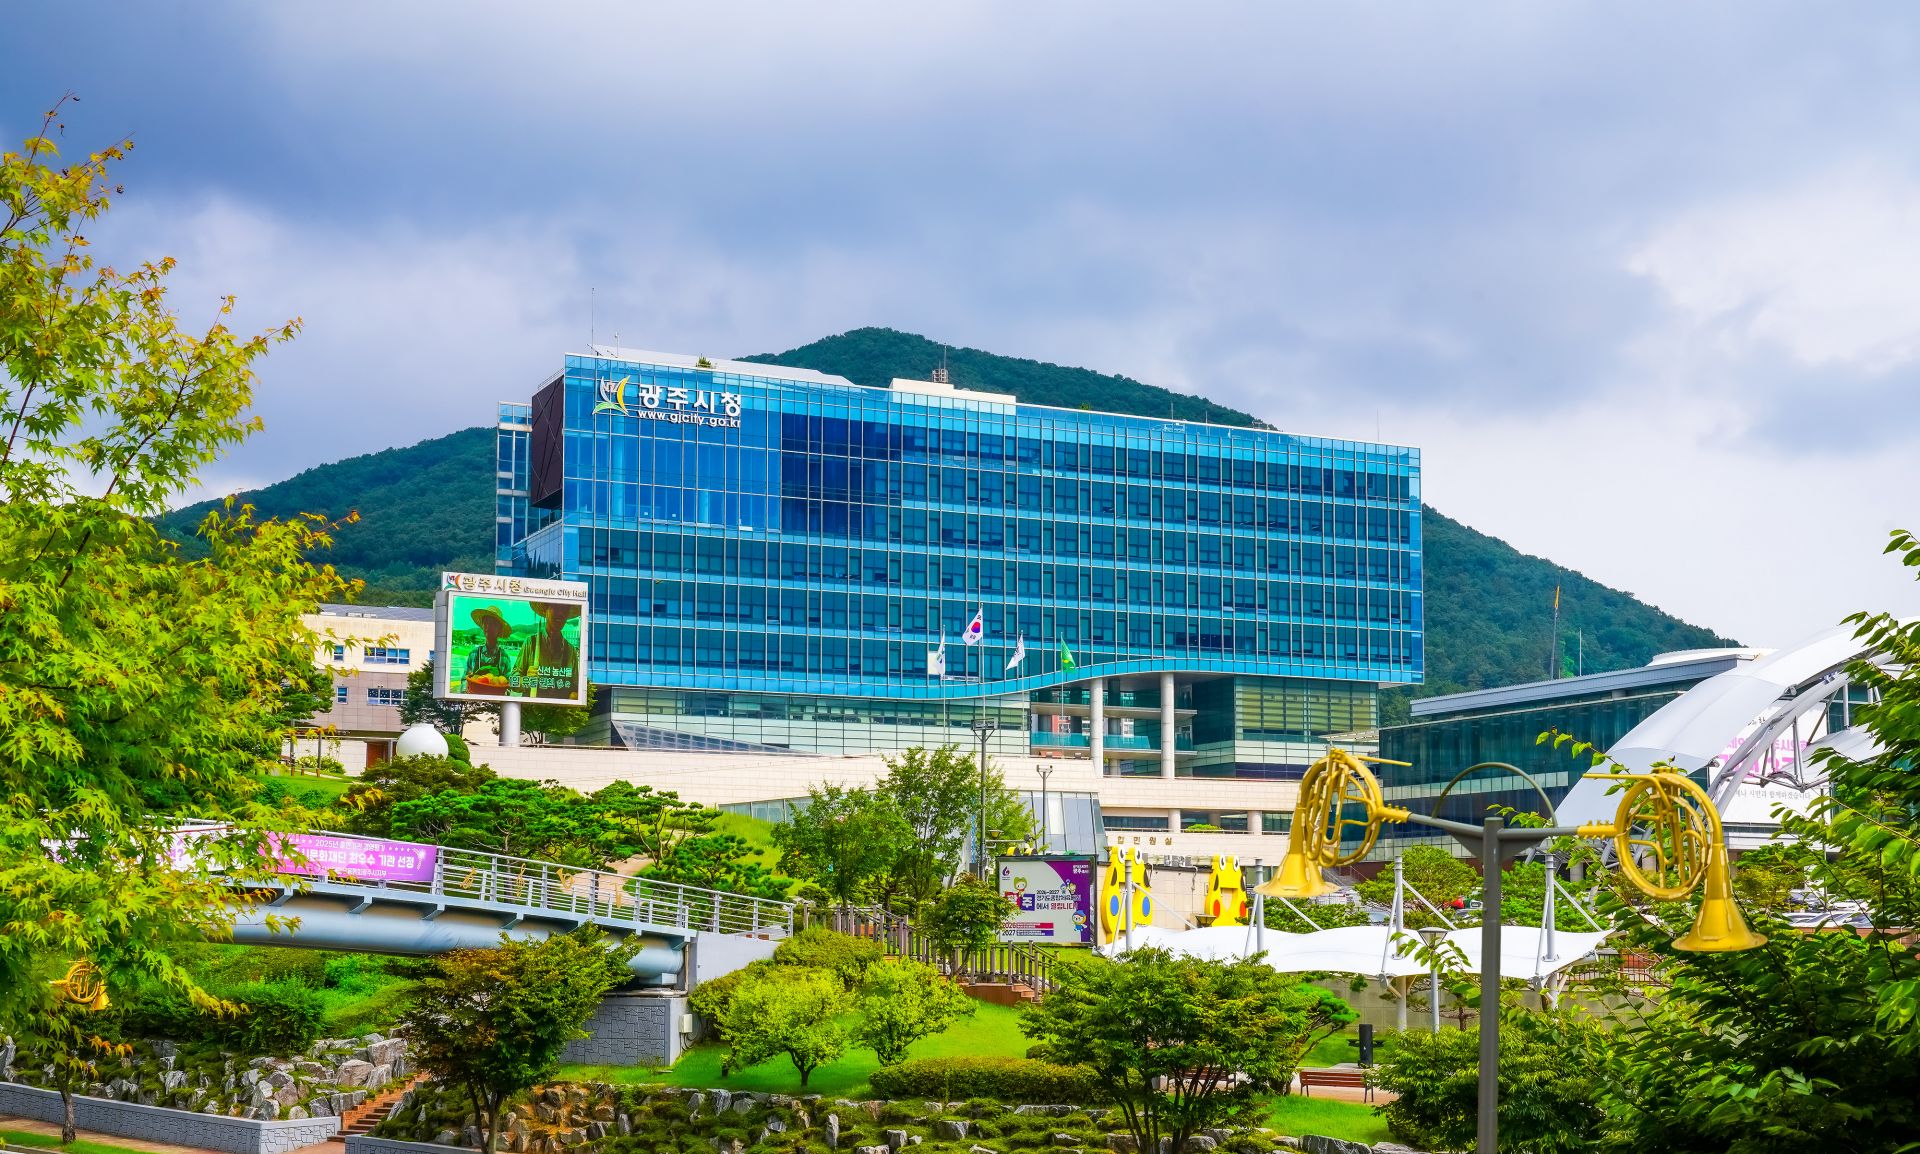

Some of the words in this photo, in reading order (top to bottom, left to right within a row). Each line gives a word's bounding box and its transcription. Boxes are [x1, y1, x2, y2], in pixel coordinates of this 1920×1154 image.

[638, 384, 741, 417] 광주시청
[637, 410, 741, 428] www.gjcity.go.kr
[463, 576, 521, 593] 광주시청
[557, 587, 571, 597] City
[572, 588, 587, 598] Hall
[537, 665, 551, 676] 신선
[552, 666, 573, 678] 농산물
[315, 838, 339, 849] 2025년
[349, 850, 376, 865] 최우수
[378, 853, 395, 867] 기관
[397, 856, 415, 869] 선정
